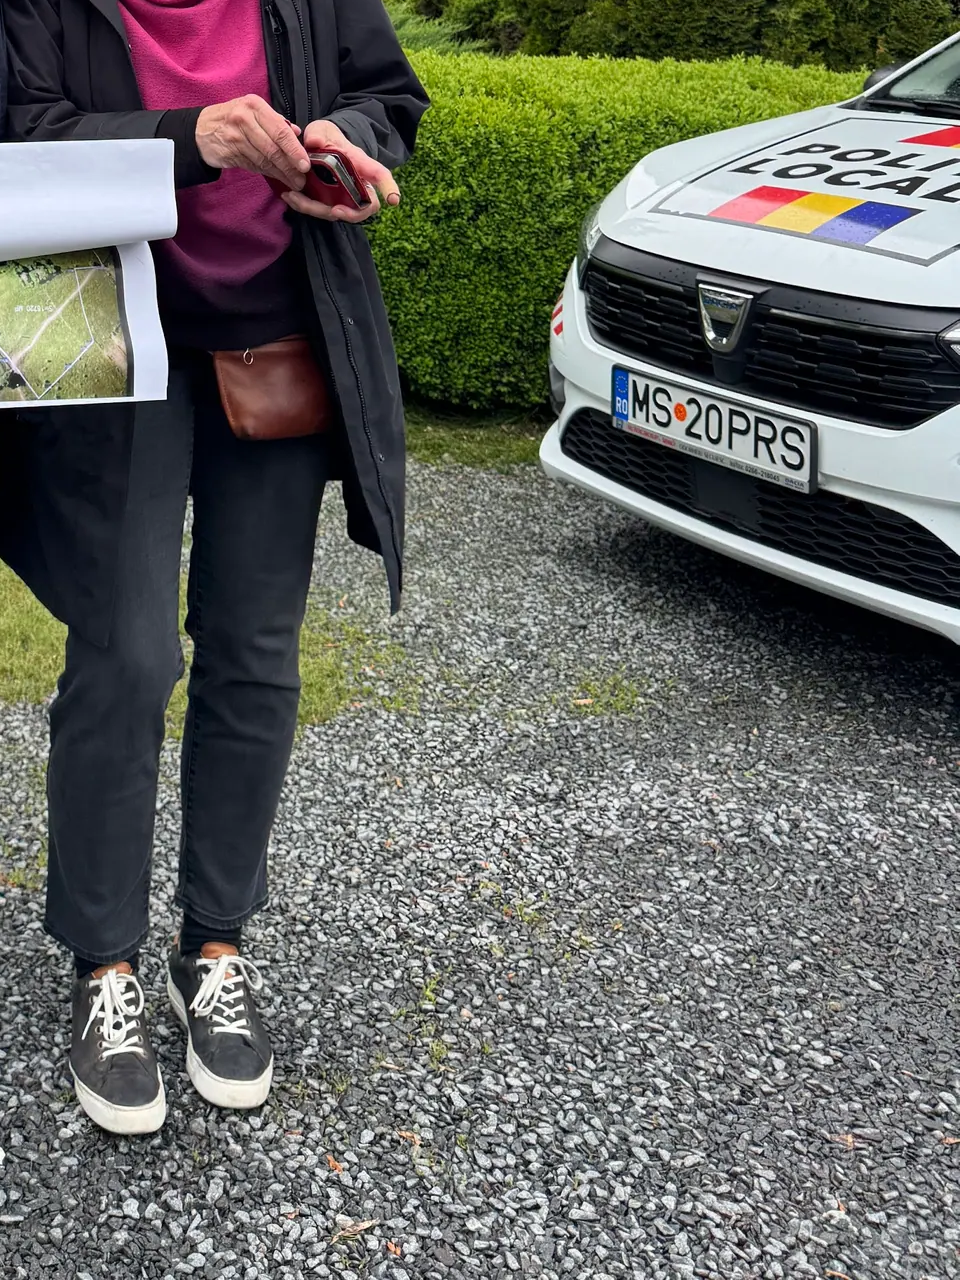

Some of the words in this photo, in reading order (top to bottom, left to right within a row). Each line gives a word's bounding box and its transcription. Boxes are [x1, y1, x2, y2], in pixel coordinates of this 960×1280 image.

[777, 143, 960, 176] POLI
[615, 396, 628, 415] RO
[685, 397, 805, 471] 20PRS
